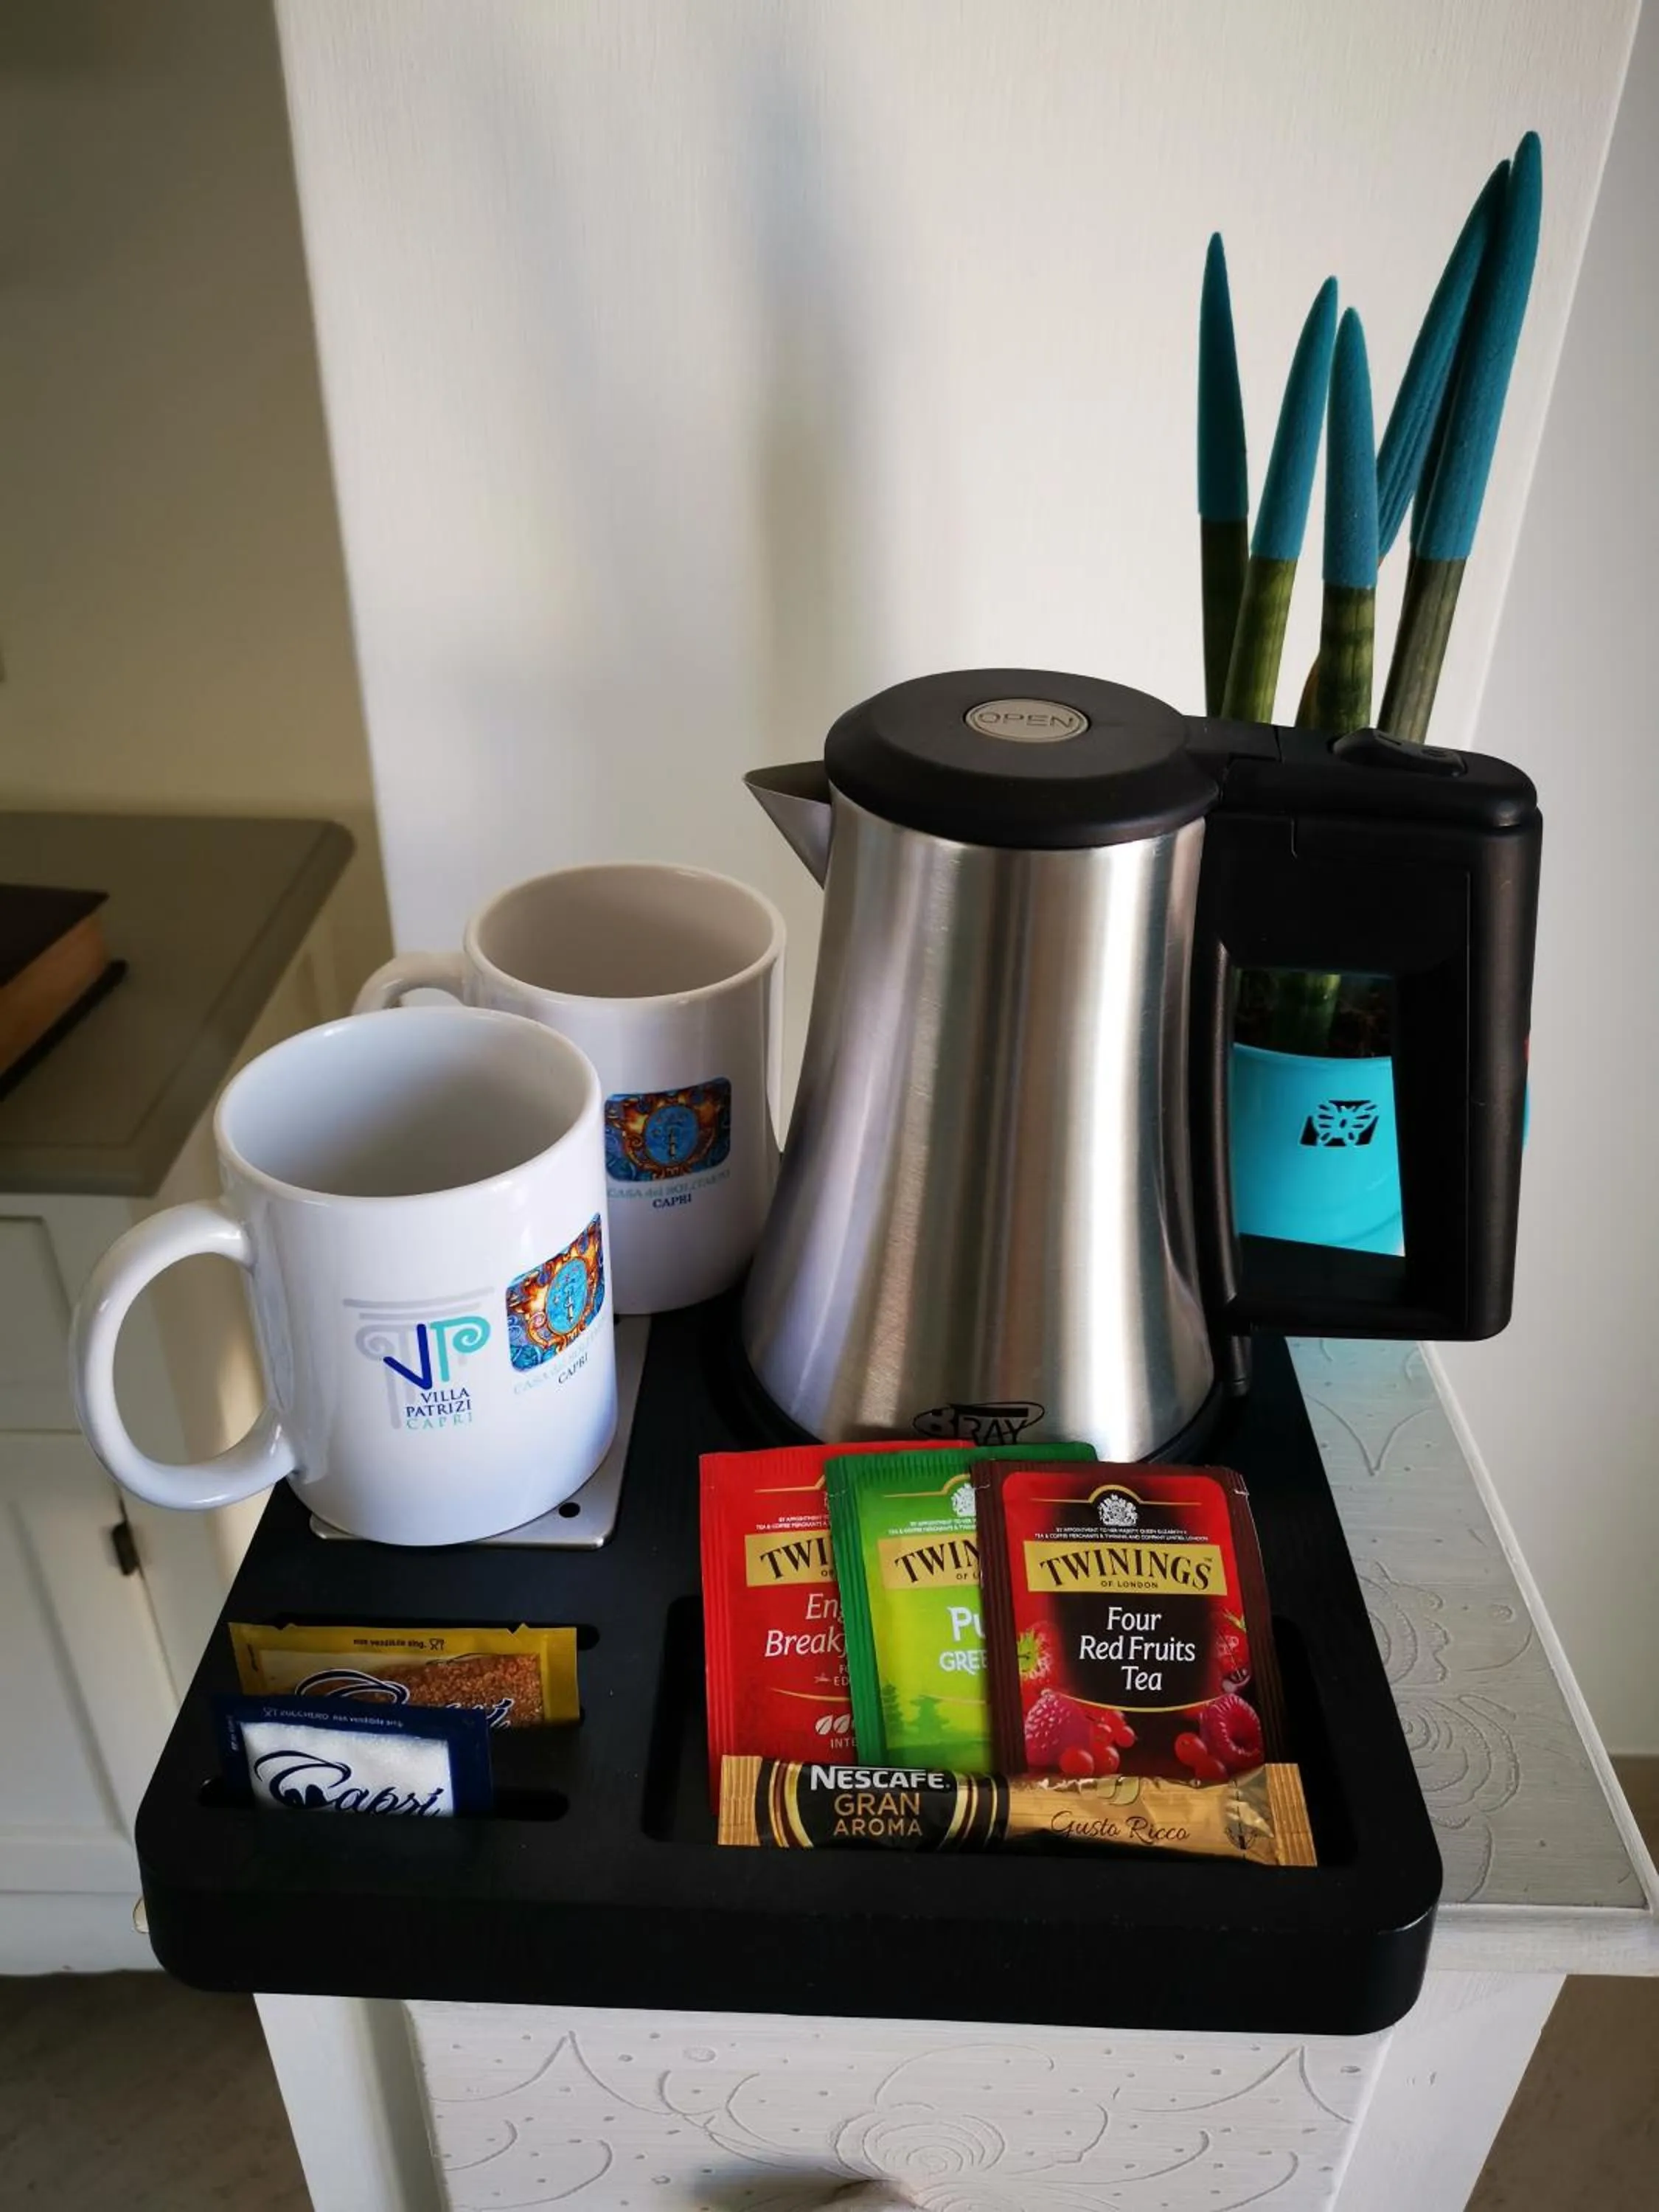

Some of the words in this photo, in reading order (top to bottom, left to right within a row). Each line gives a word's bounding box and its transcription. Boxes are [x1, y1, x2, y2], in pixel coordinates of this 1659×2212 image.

[978, 712, 1074, 728] OPEN
[653, 1194, 692, 1208] CAPRI
[420, 1387, 470, 1404] VILLA
[406, 1399, 471, 1417] PATRIZI
[406, 1411, 473, 1429] CAPRI
[1040, 1548, 1211, 1591] TWININGS
[1117, 1580, 1158, 1588] LONDON
[1107, 1607, 1162, 1631] Four
[1079, 1635, 1124, 1660] Red
[1127, 1636, 1195, 1661] Fruits
[1121, 1666, 1163, 1691] Tea
[834, 1792, 920, 1816] GRAN
[833, 1818, 922, 1837] AROMA
[1051, 1810, 1121, 1837] Gusto
[1125, 1816, 1191, 1845] Ricco
